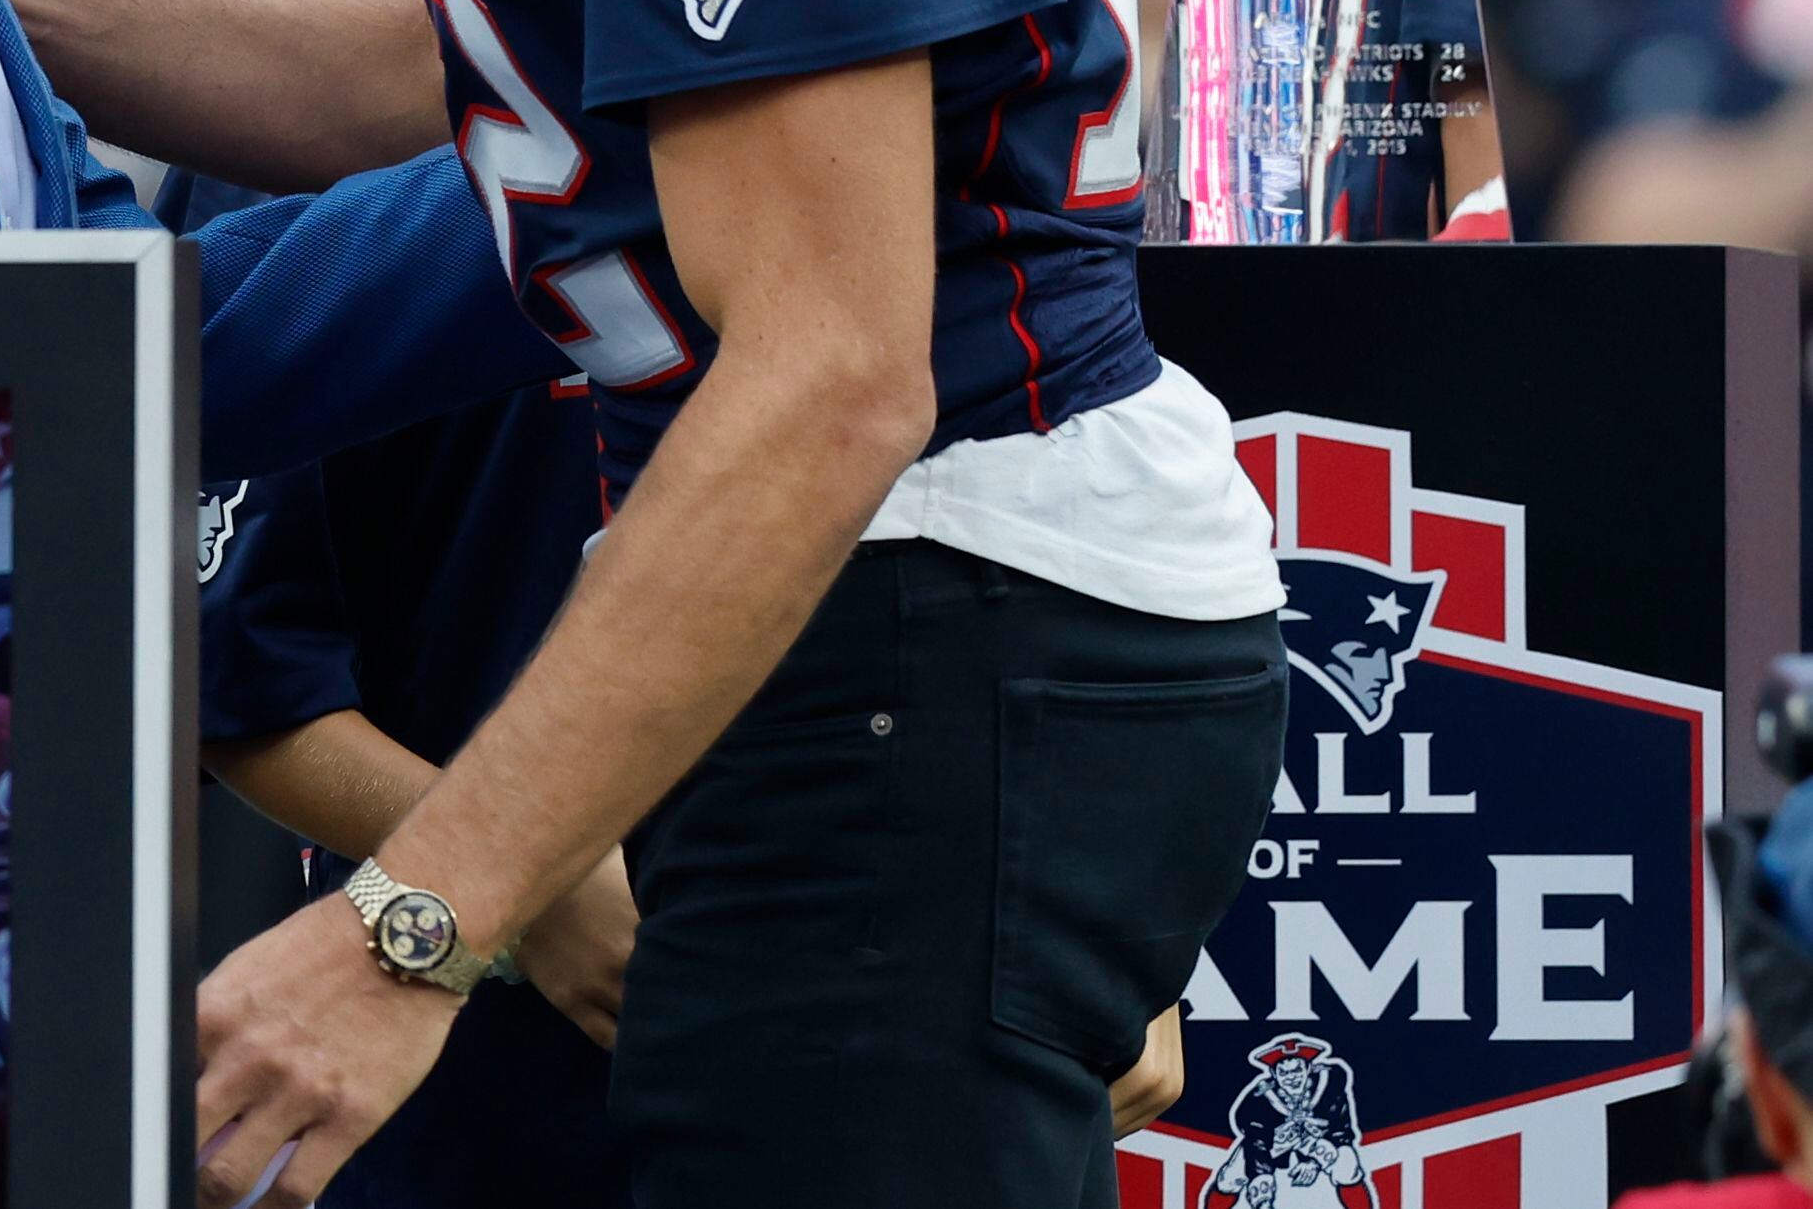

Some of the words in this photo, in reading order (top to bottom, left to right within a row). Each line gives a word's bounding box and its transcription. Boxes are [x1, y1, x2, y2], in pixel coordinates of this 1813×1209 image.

[1439, 43, 1466, 61] 28
[1341, 120, 1424, 137] ARIZONA
[1366, 139, 1407, 155] 2015
[1247, 839, 1320, 880] OF
